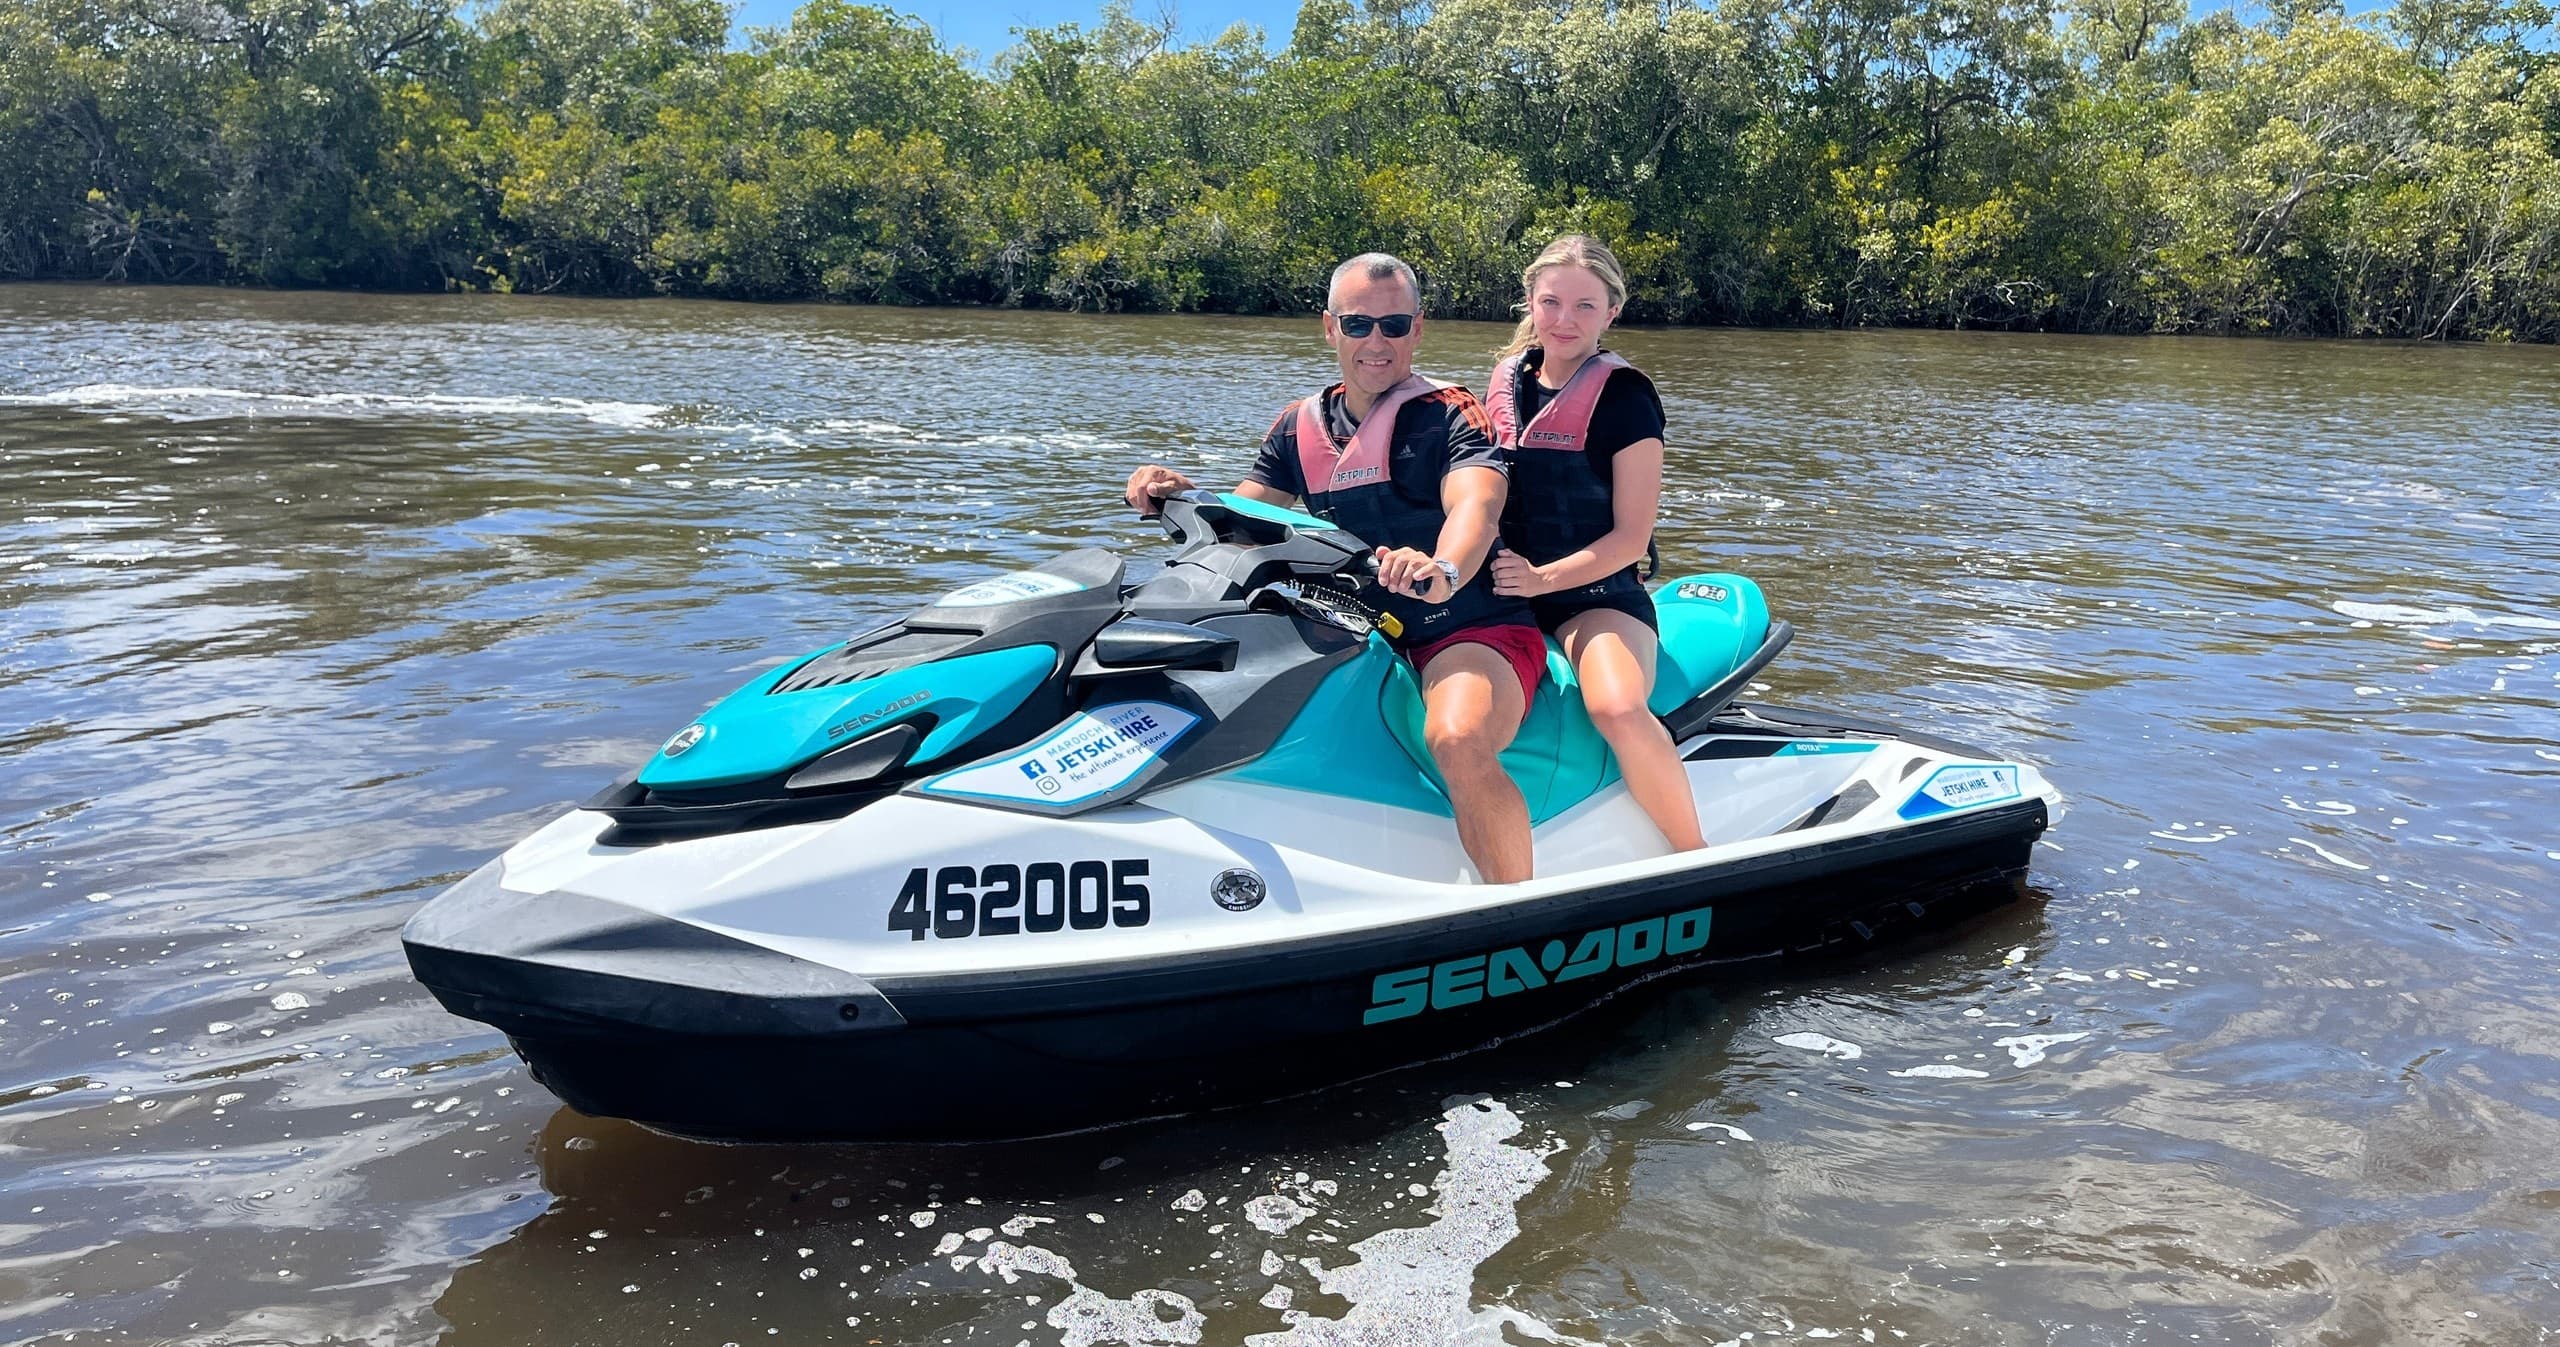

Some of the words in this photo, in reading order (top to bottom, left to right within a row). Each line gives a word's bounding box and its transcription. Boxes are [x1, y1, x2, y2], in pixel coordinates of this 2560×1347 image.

[1110, 706, 1144, 726] RIVER
[1056, 735, 1117, 774] JETSKI
[1114, 715, 1158, 742] HIRE
[1069, 773, 1087, 783] the
[1088, 752, 1126, 774] ultimate
[1127, 731, 1169, 754] experience
[1941, 783, 1969, 797] JETSKI
[1968, 778, 1989, 790] HIRE
[888, 859, 1151, 941] 462005
